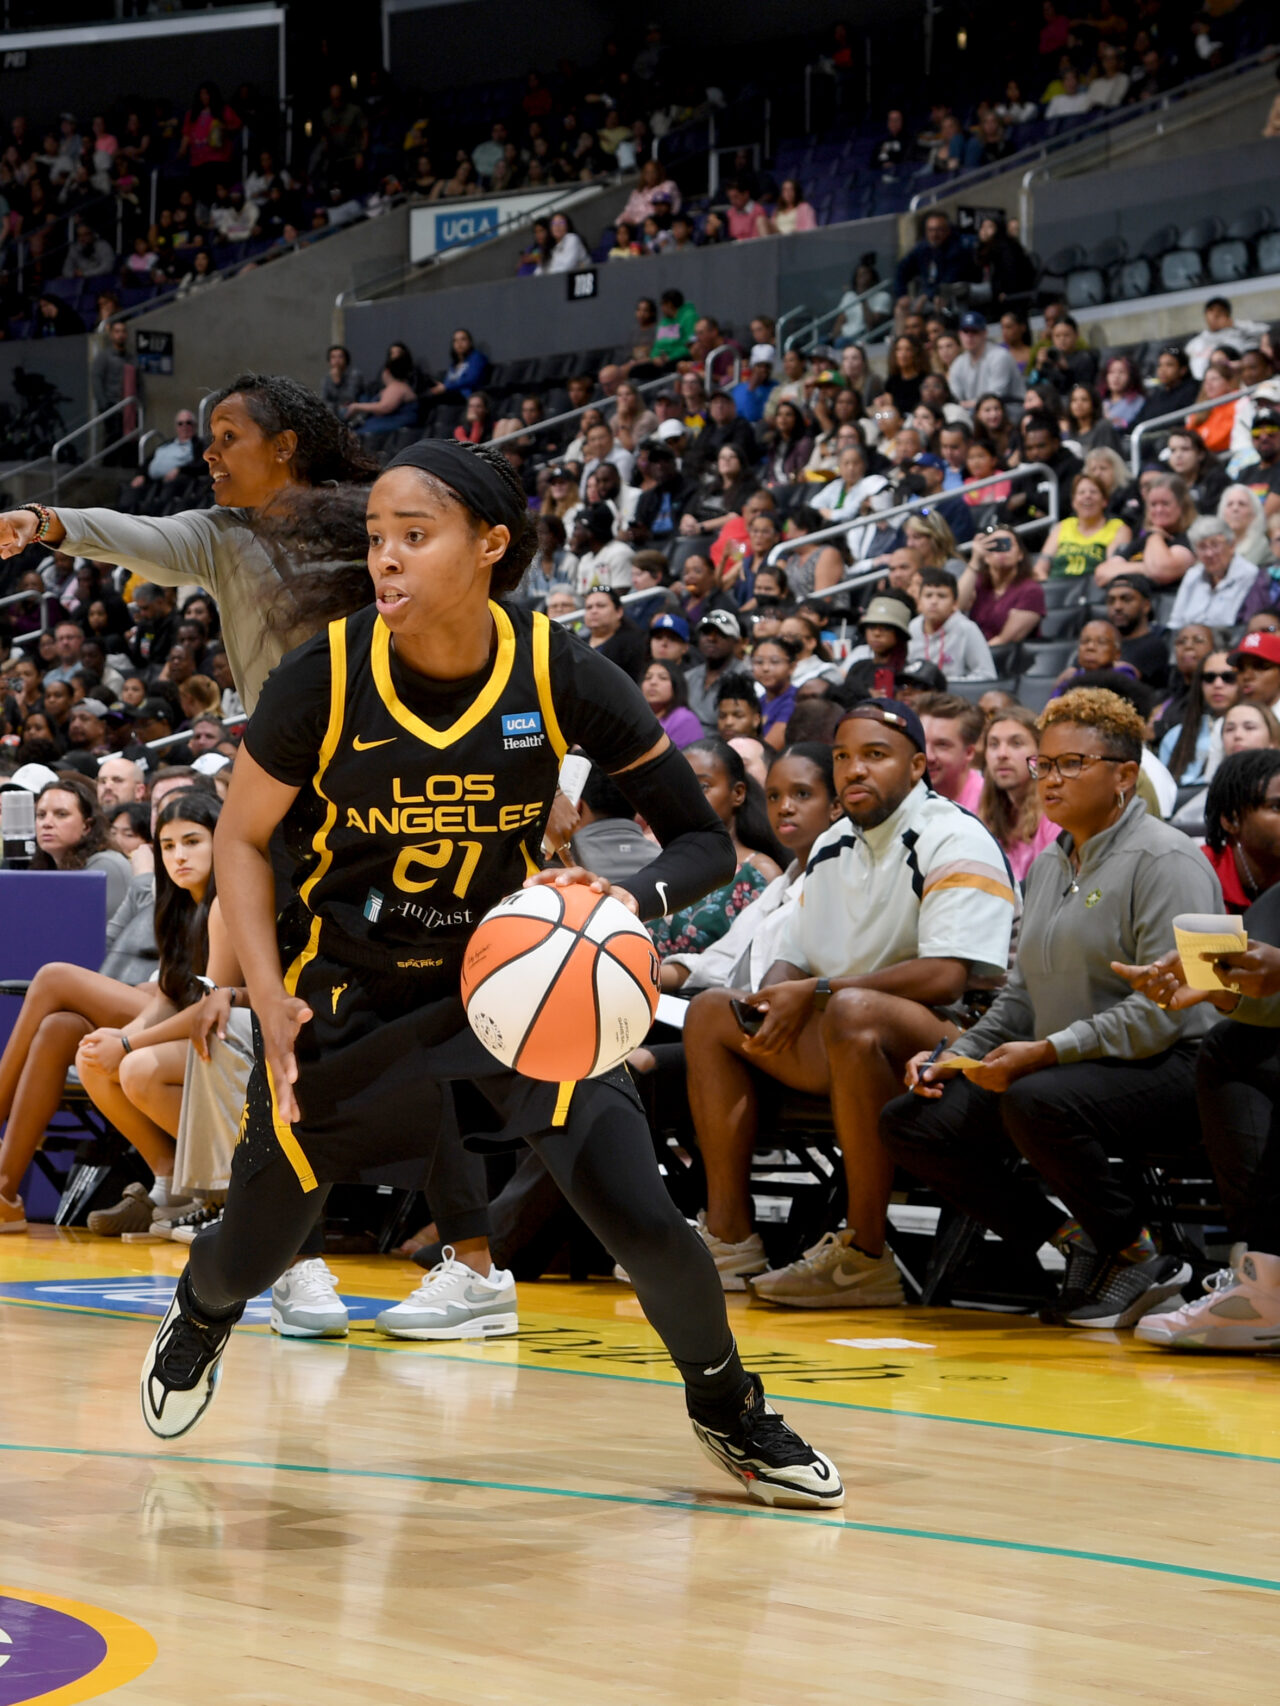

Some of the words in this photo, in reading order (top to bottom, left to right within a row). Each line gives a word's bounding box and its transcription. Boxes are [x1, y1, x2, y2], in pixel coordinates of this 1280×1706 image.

[442, 216, 492, 243] UCLA
[507, 718, 536, 731] UCLA
[503, 734, 543, 750] Health
[392, 774, 495, 804] LOS
[345, 801, 543, 834] ANGELES
[392, 838, 483, 900] 21
[396, 958, 444, 968] SPARKS
